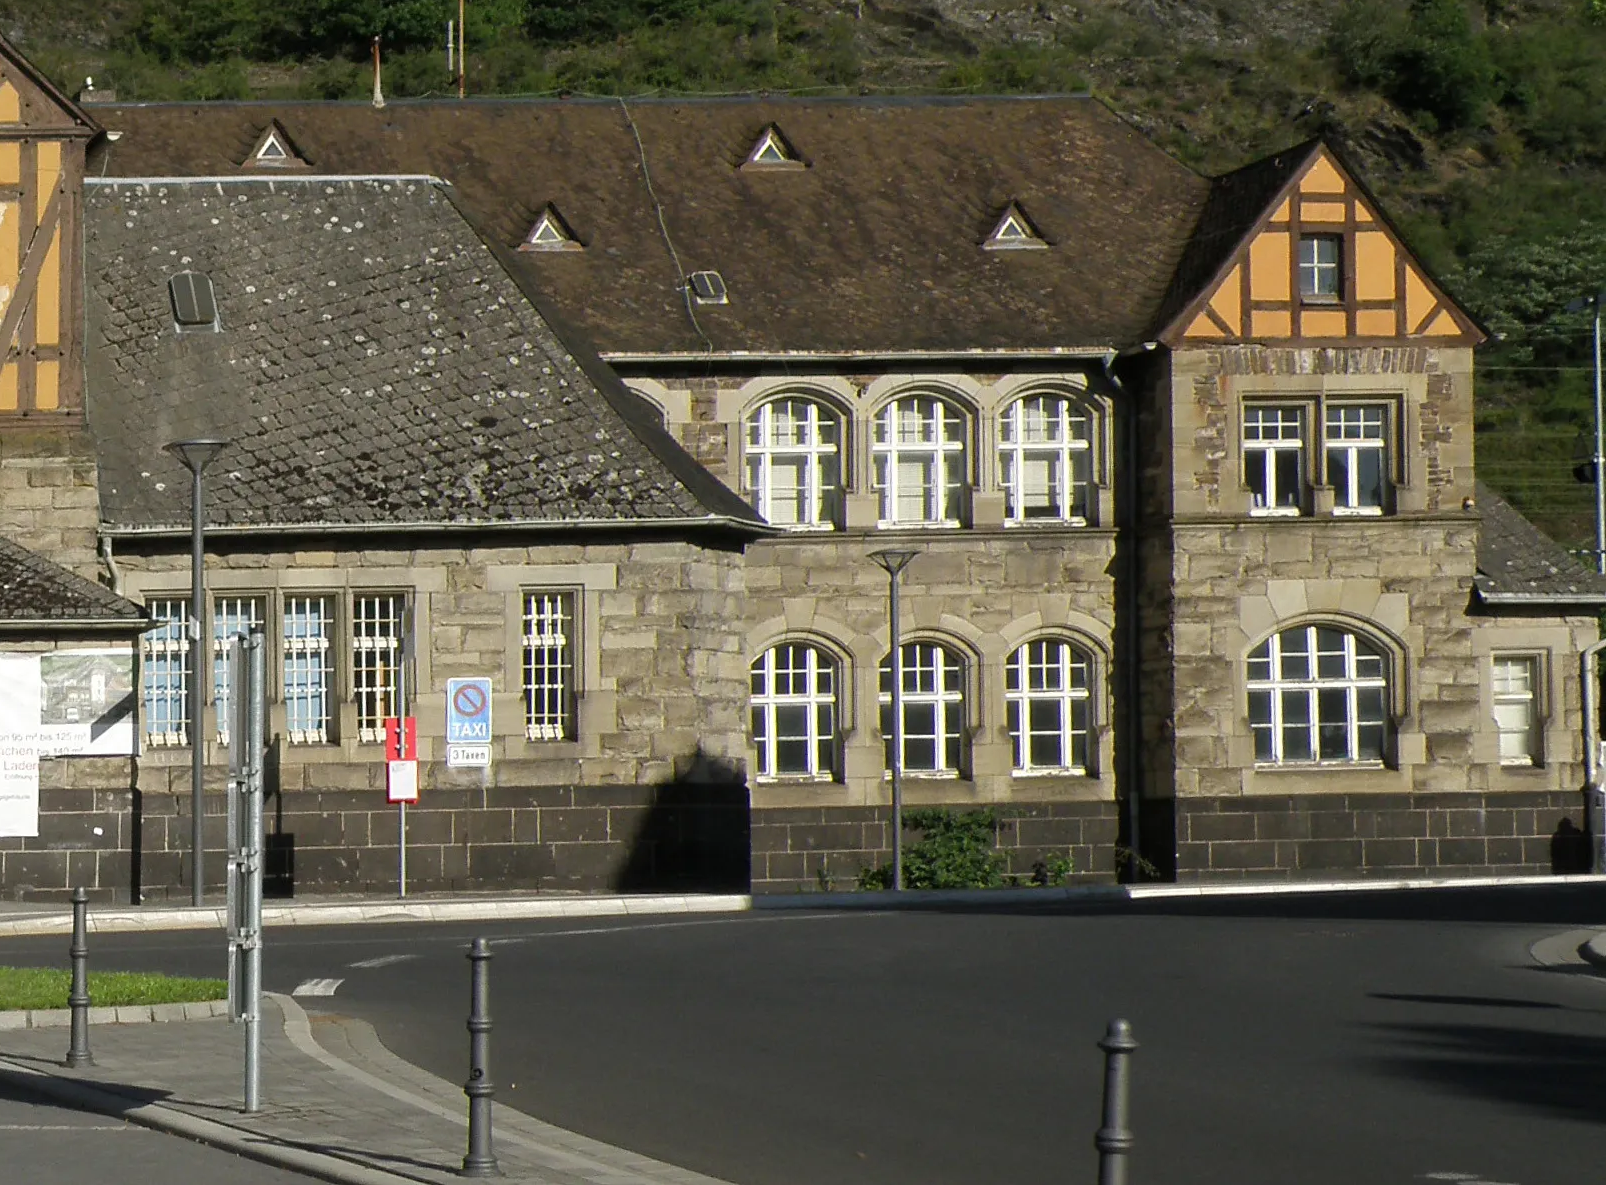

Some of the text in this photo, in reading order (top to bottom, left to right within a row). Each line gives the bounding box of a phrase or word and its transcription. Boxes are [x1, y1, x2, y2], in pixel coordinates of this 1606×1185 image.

[452, 722, 487, 737] TAXI
[39, 732, 52, 742] bis
[453, 750, 486, 760] 3 Taxen
